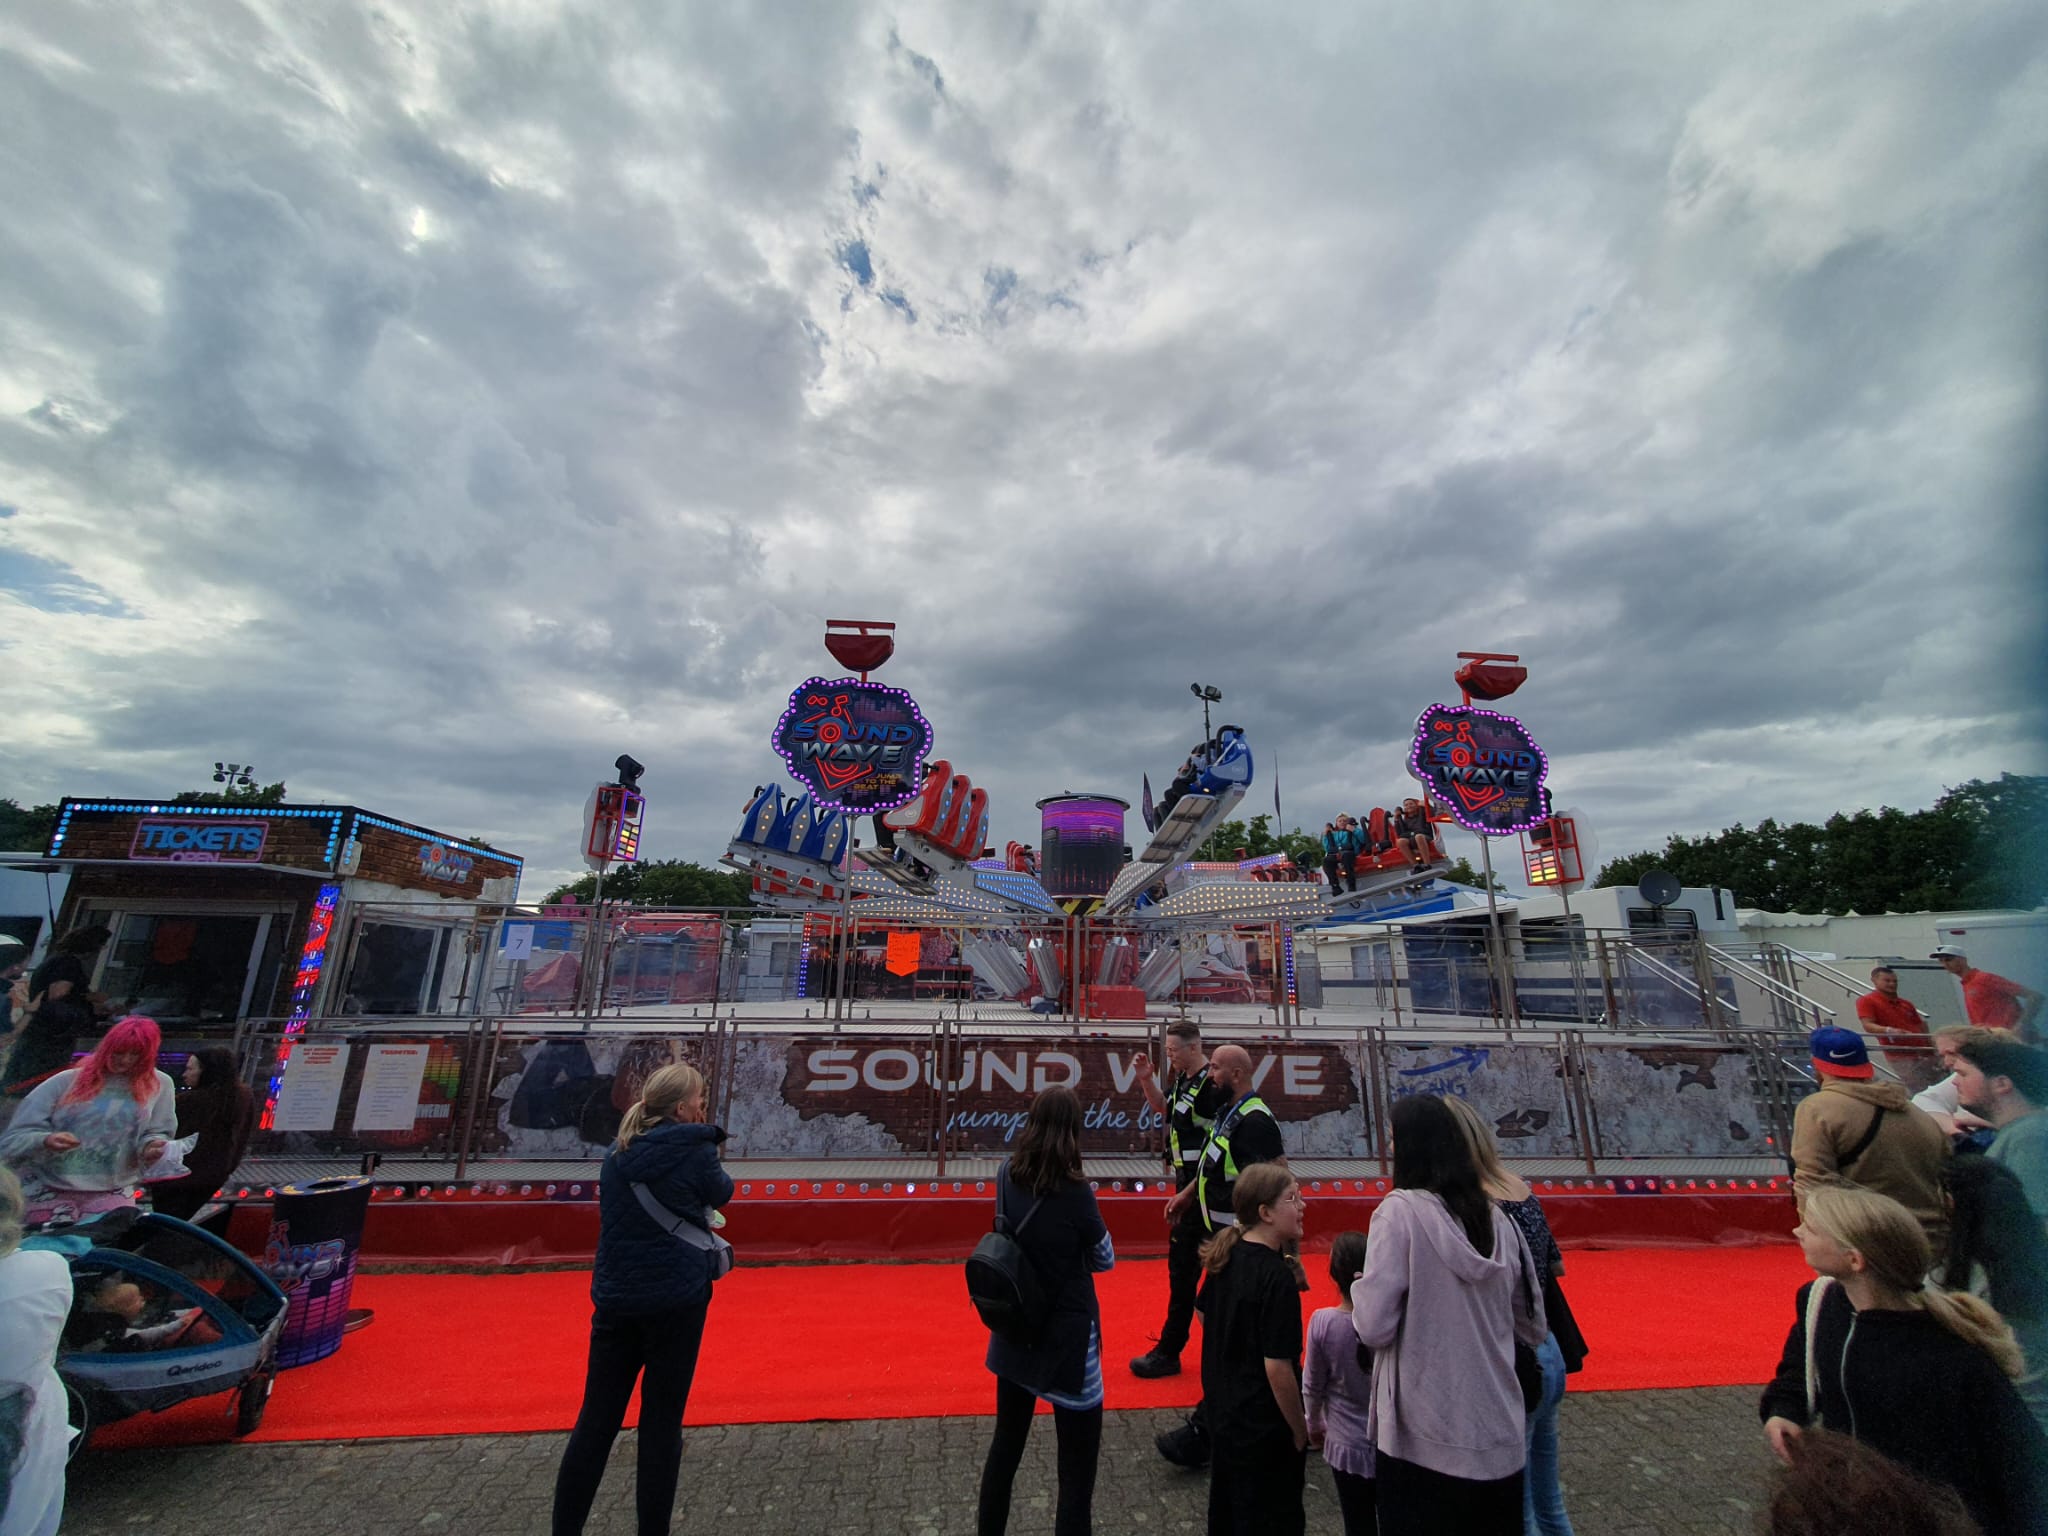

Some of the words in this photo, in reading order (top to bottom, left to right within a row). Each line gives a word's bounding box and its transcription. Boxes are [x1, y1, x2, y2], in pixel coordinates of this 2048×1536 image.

[791, 717, 916, 746] SOUND
[802, 742, 904, 763] WAVE
[1430, 746, 1537, 769] SOUND
[1442, 766, 1530, 786] WAVE
[141, 825, 263, 851] TICKETS
[169, 851, 220, 862] OPEN
[418, 842, 474, 871] SOUND
[421, 860, 468, 884] WAVE
[515, 939, 523, 950] 7
[805, 1049, 1082, 1093] SOUND
[1106, 1053, 1326, 1095] WVE
[1084, 1098, 1129, 1130] the
